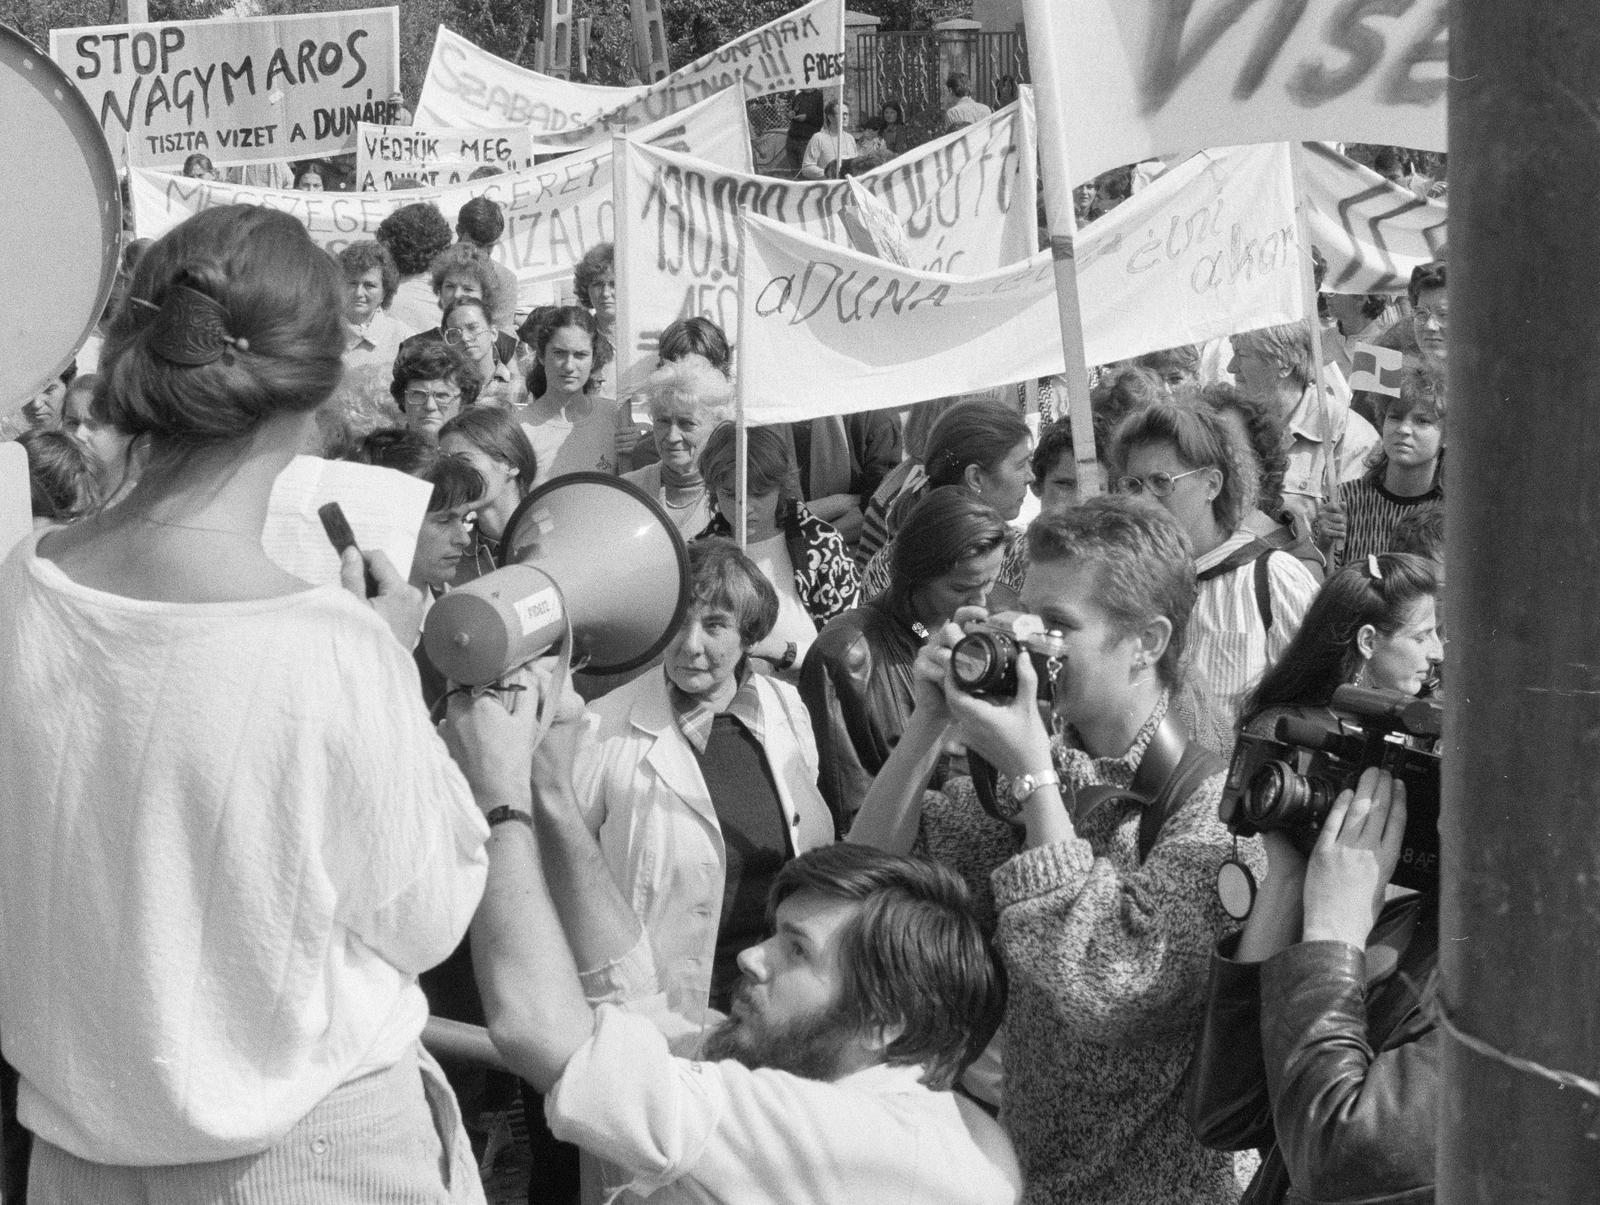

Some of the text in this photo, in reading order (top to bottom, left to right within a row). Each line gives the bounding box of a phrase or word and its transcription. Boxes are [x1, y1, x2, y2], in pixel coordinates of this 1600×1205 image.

[75, 26, 186, 80] STOP
[100, 29, 369, 133] NAGYMAROS
[145, 129, 209, 155] TISZTA
[216, 124, 278, 149] VIZET
[290, 122, 307, 143] A
[460, 137, 513, 163] MEG
[361, 168, 379, 193] A
[384, 163, 440, 192] DÁT
